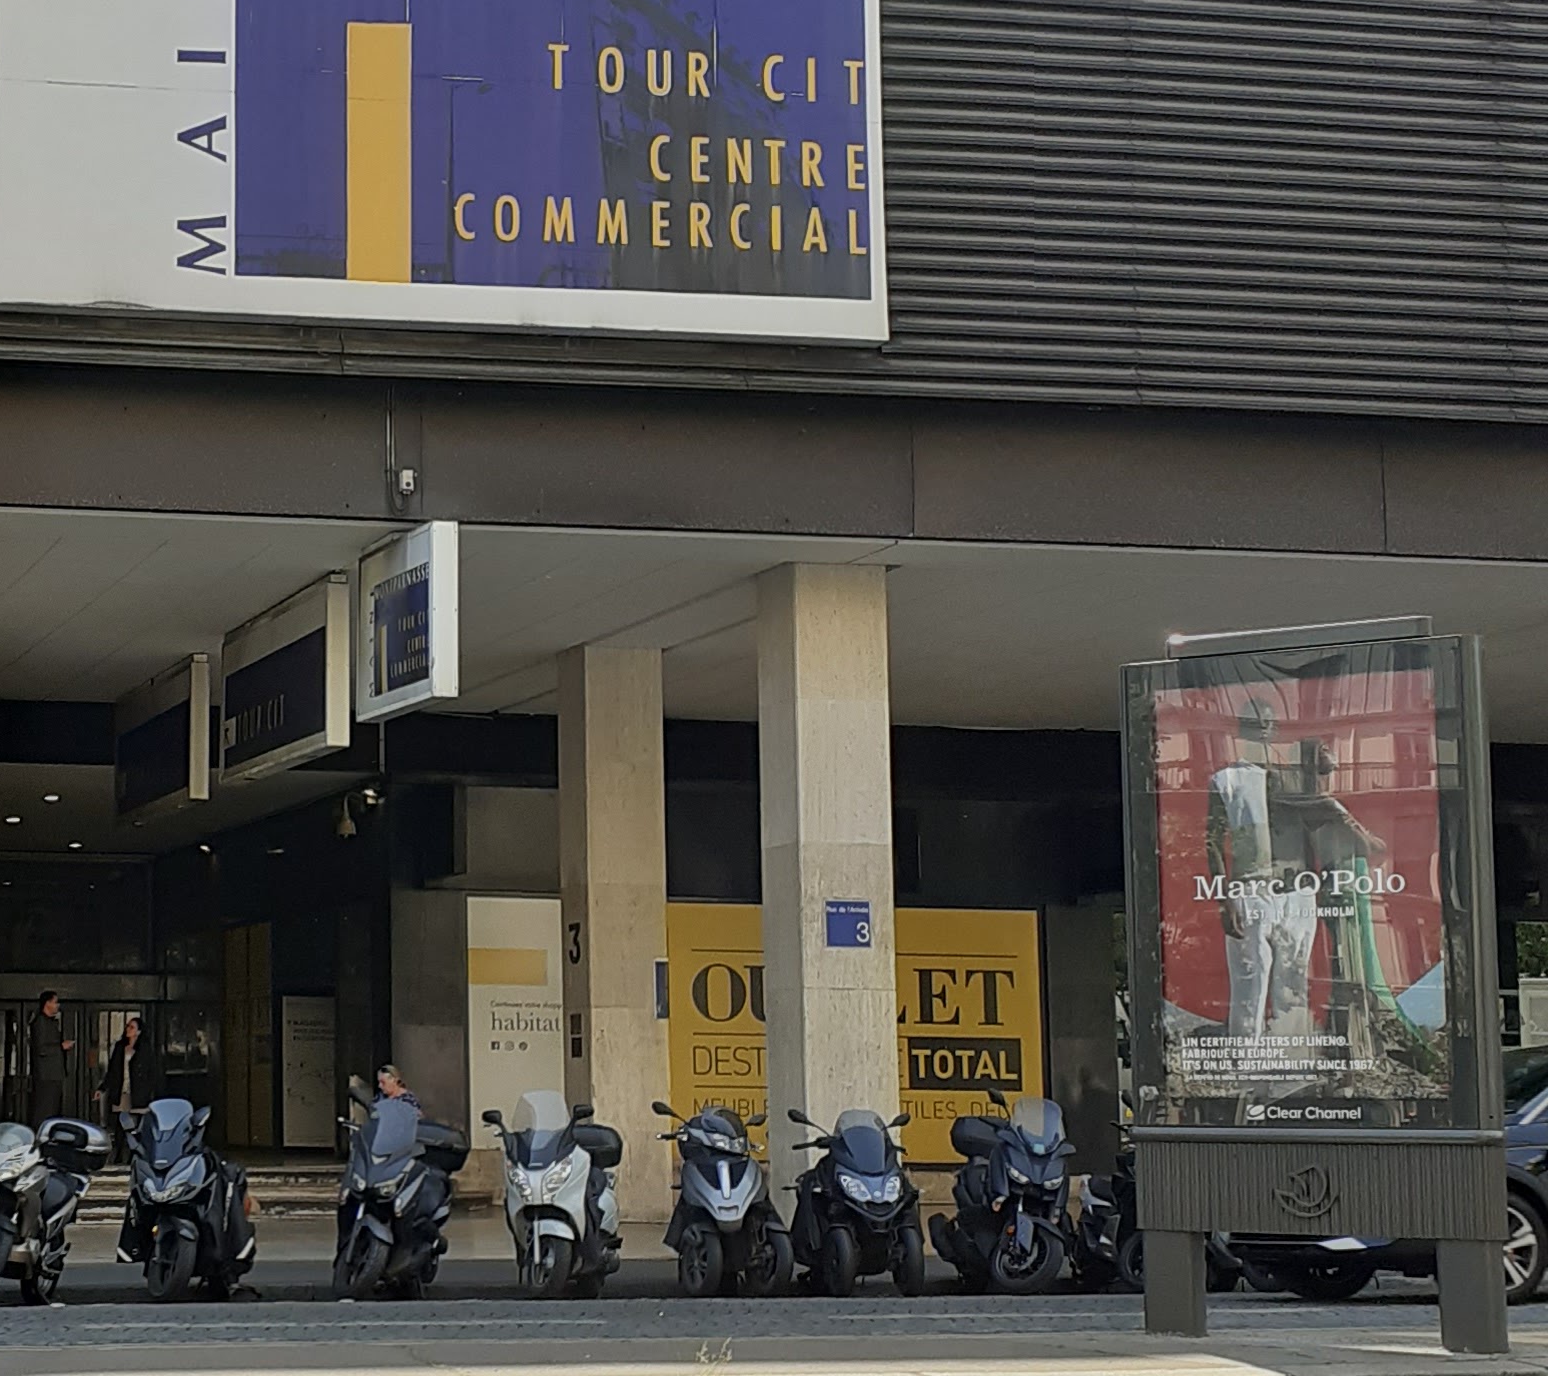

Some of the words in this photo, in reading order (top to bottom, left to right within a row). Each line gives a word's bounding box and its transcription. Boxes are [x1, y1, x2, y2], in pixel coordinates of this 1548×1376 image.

[549, 43, 710, 97] TOUR
[764, 53, 865, 105] CIT
[650, 134, 866, 191] CENTRE
[454, 192, 866, 257] COMMERCIAL
[1193, 874, 1284, 900] Marc
[1294, 868, 1406, 897] O'Polo
[568, 923, 581, 964] 3
[856, 922, 870, 943] 3
[491, 1010, 561, 1031] habitat
[1182, 1037, 1198, 1047] LIN
[1292, 1036, 1305, 1046] OF
[1232, 1049, 1245, 1058] EN
[1248, 1048, 1288, 1059] EUROPE.
[912, 1049, 1018, 1080] TOTAL
[1203, 1060, 1217, 1070] ON
[1237, 1060, 1315, 1070] SUSTAINABILITY
[1317, 1059, 1347, 1070] SINCE
[1266, 1106, 1302, 1119] Clear
[1304, 1106, 1362, 1120] Channel
